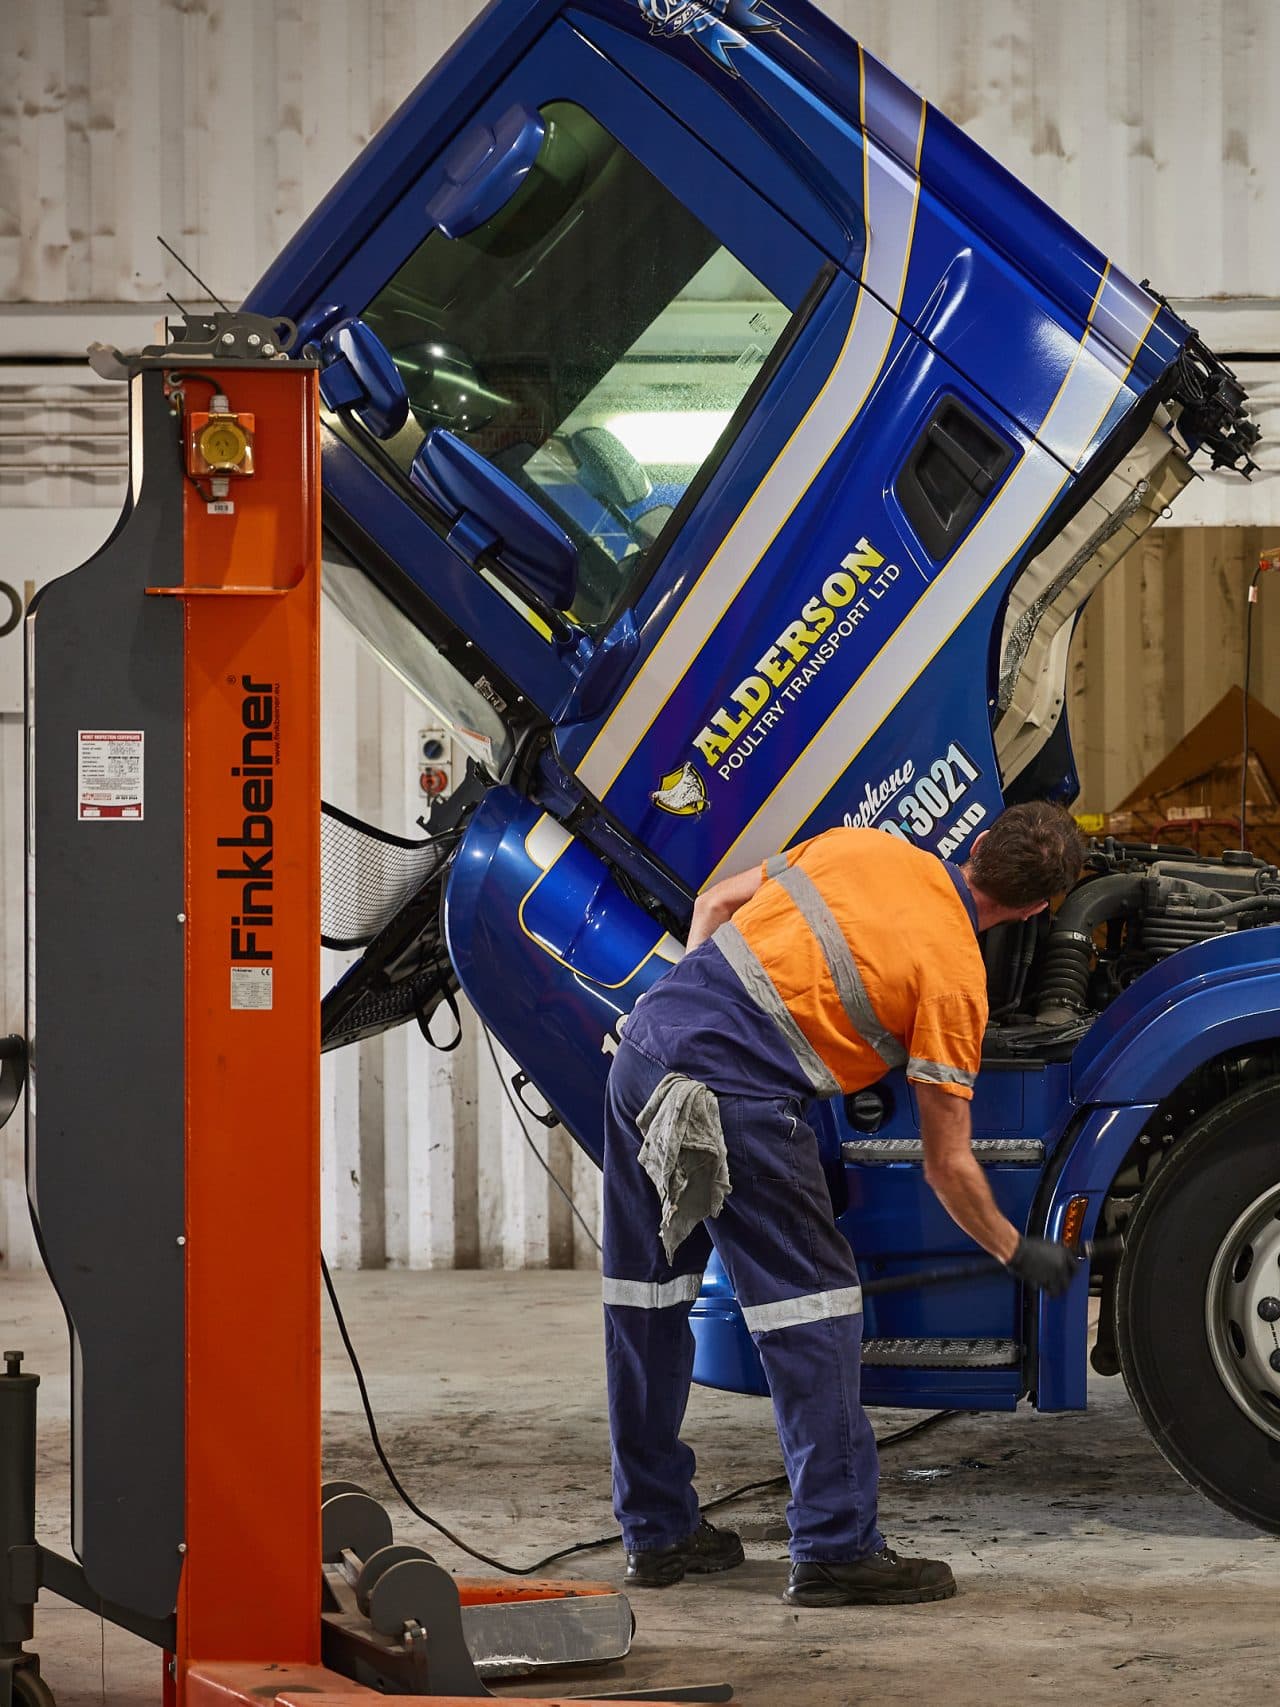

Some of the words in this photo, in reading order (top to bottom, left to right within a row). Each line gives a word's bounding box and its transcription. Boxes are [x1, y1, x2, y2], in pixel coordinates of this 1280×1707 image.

[692, 536, 886, 767] ALDERSON
[718, 700, 786, 781] POULTRY
[781, 597, 872, 702] TRANSPORT
[868, 563, 901, 600] LTD
[217, 675, 273, 960] Finkbeiner
[936, 802, 987, 860] AND
